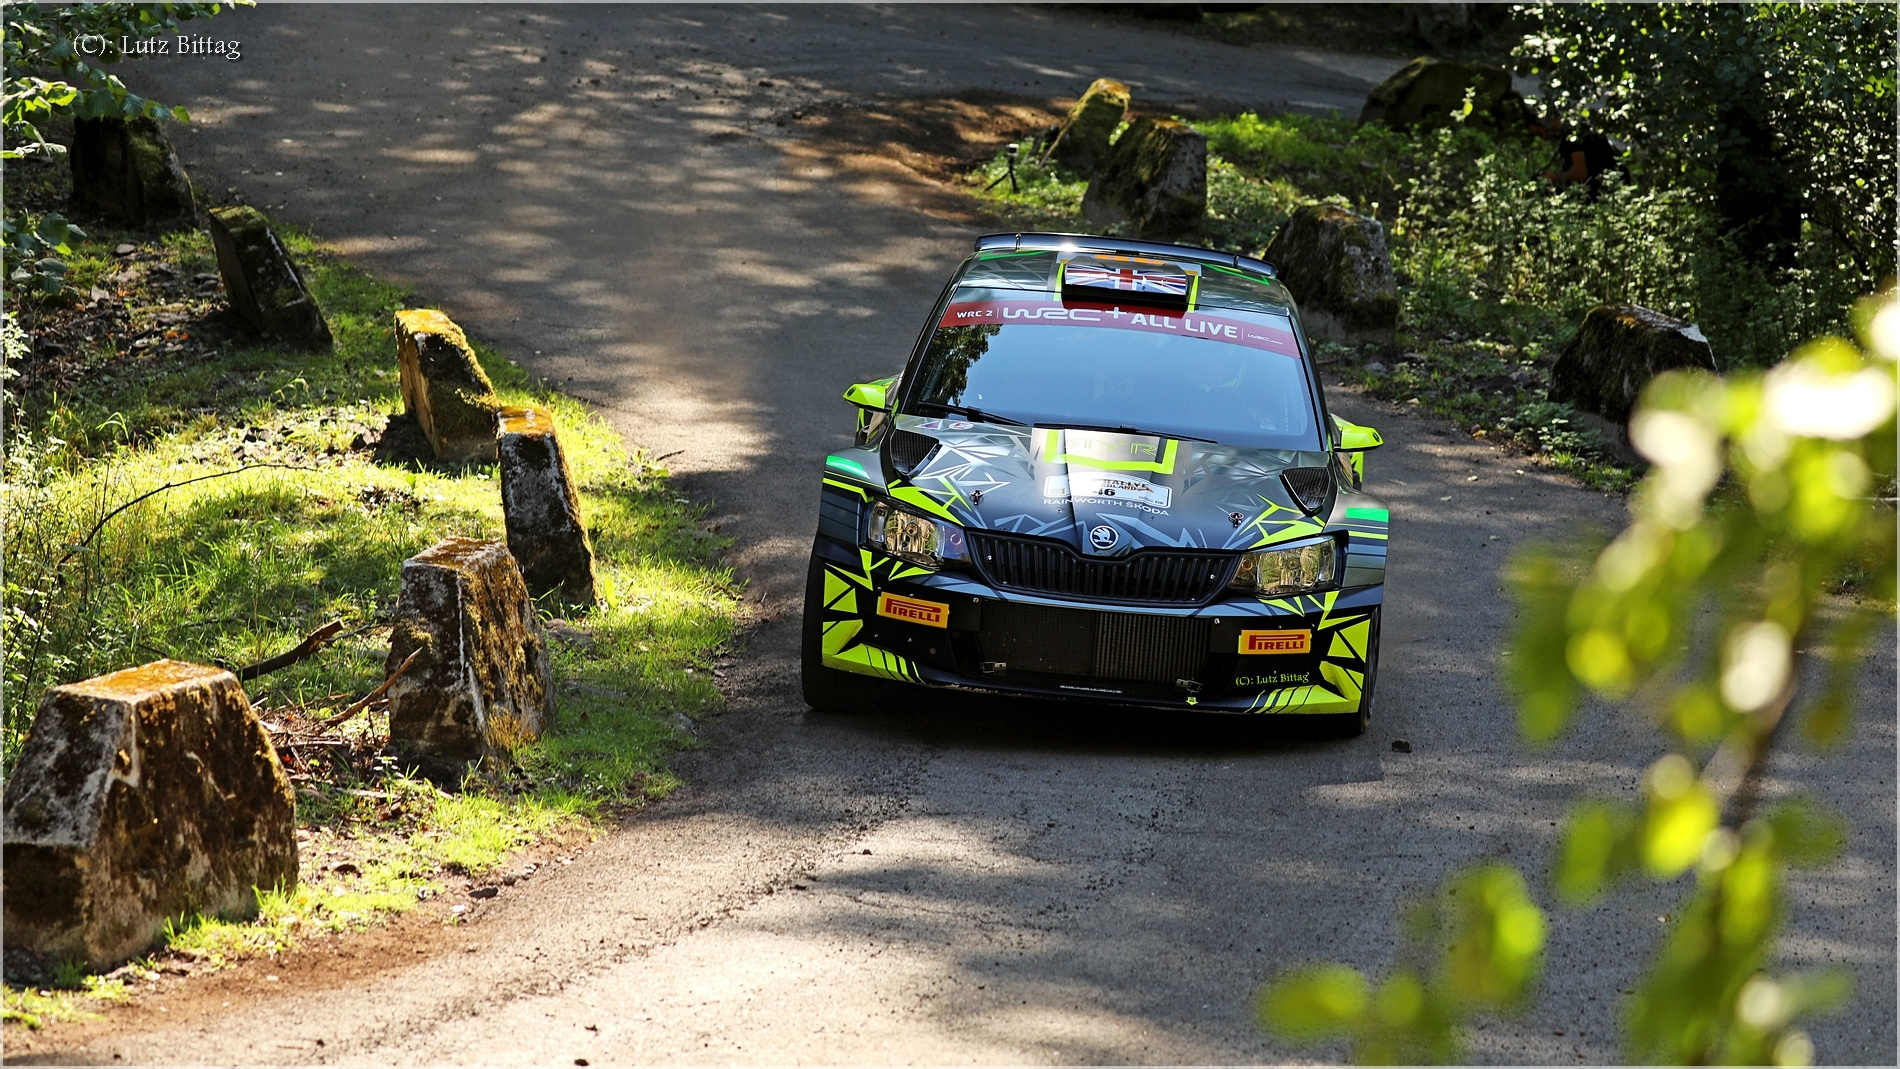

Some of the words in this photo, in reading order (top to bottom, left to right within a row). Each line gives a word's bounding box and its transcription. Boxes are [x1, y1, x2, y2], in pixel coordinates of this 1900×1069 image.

[956, 310, 982, 318] WRC
[1131, 313, 1177, 329] ALL
[1185, 319, 1238, 339] LIVE
[1043, 498, 1124, 506] RAINWORTH
[885, 598, 941, 623] PIRELLI
[1248, 634, 1305, 650] PIRELLI
